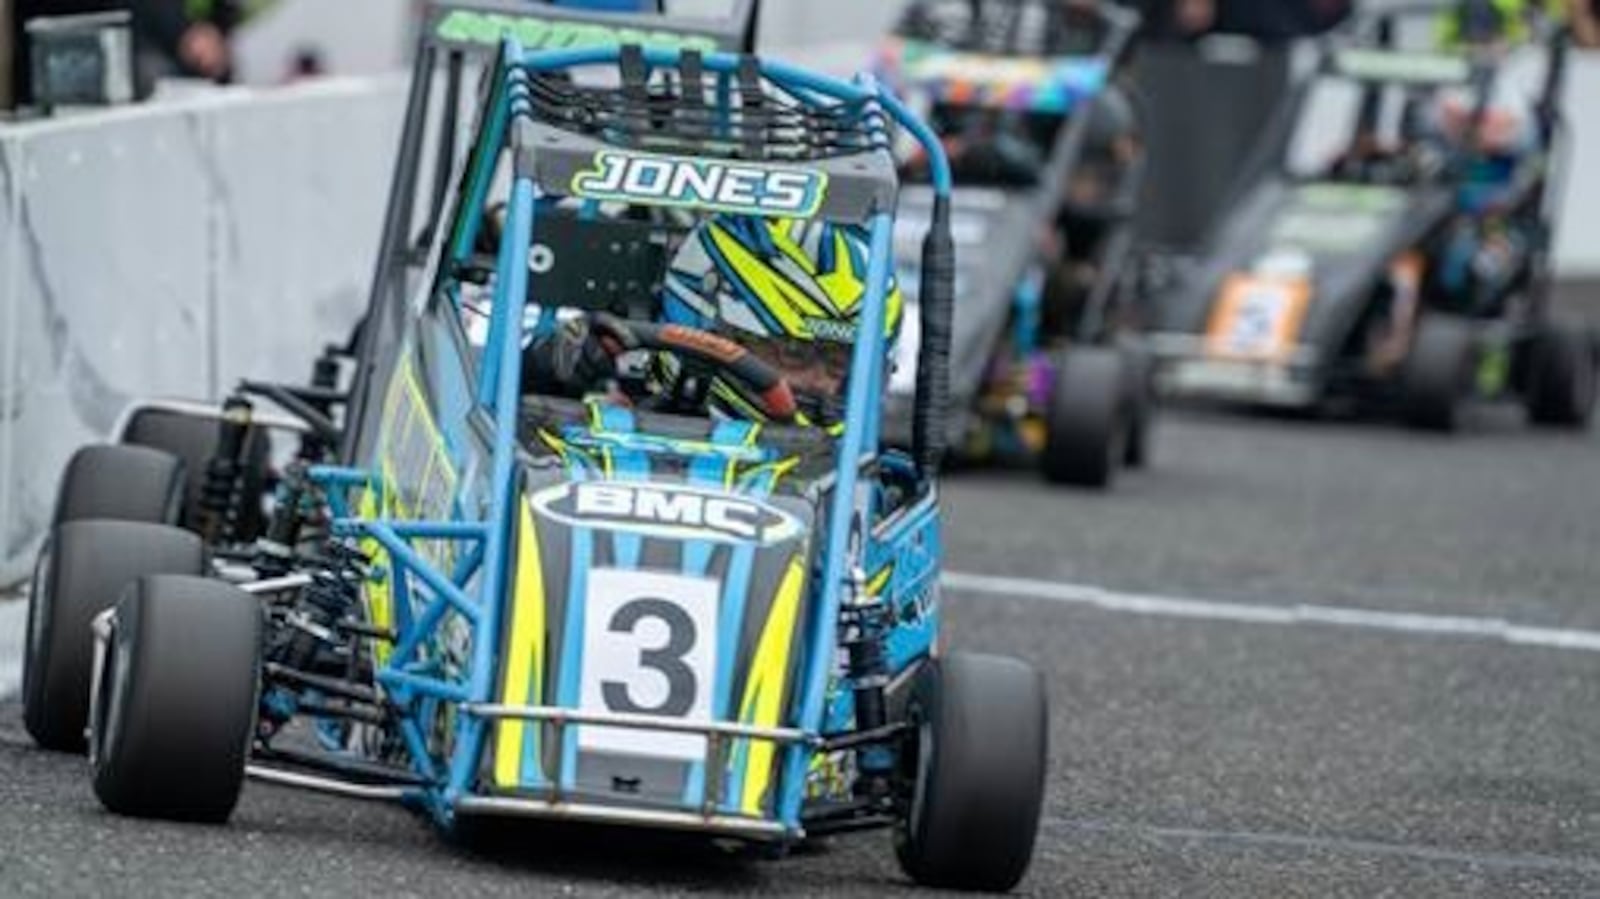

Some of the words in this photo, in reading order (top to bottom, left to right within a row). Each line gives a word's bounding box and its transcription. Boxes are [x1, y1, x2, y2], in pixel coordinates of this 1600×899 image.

[583, 157, 809, 208] JONES
[577, 485, 761, 536] BMC
[601, 597, 698, 718] 3
